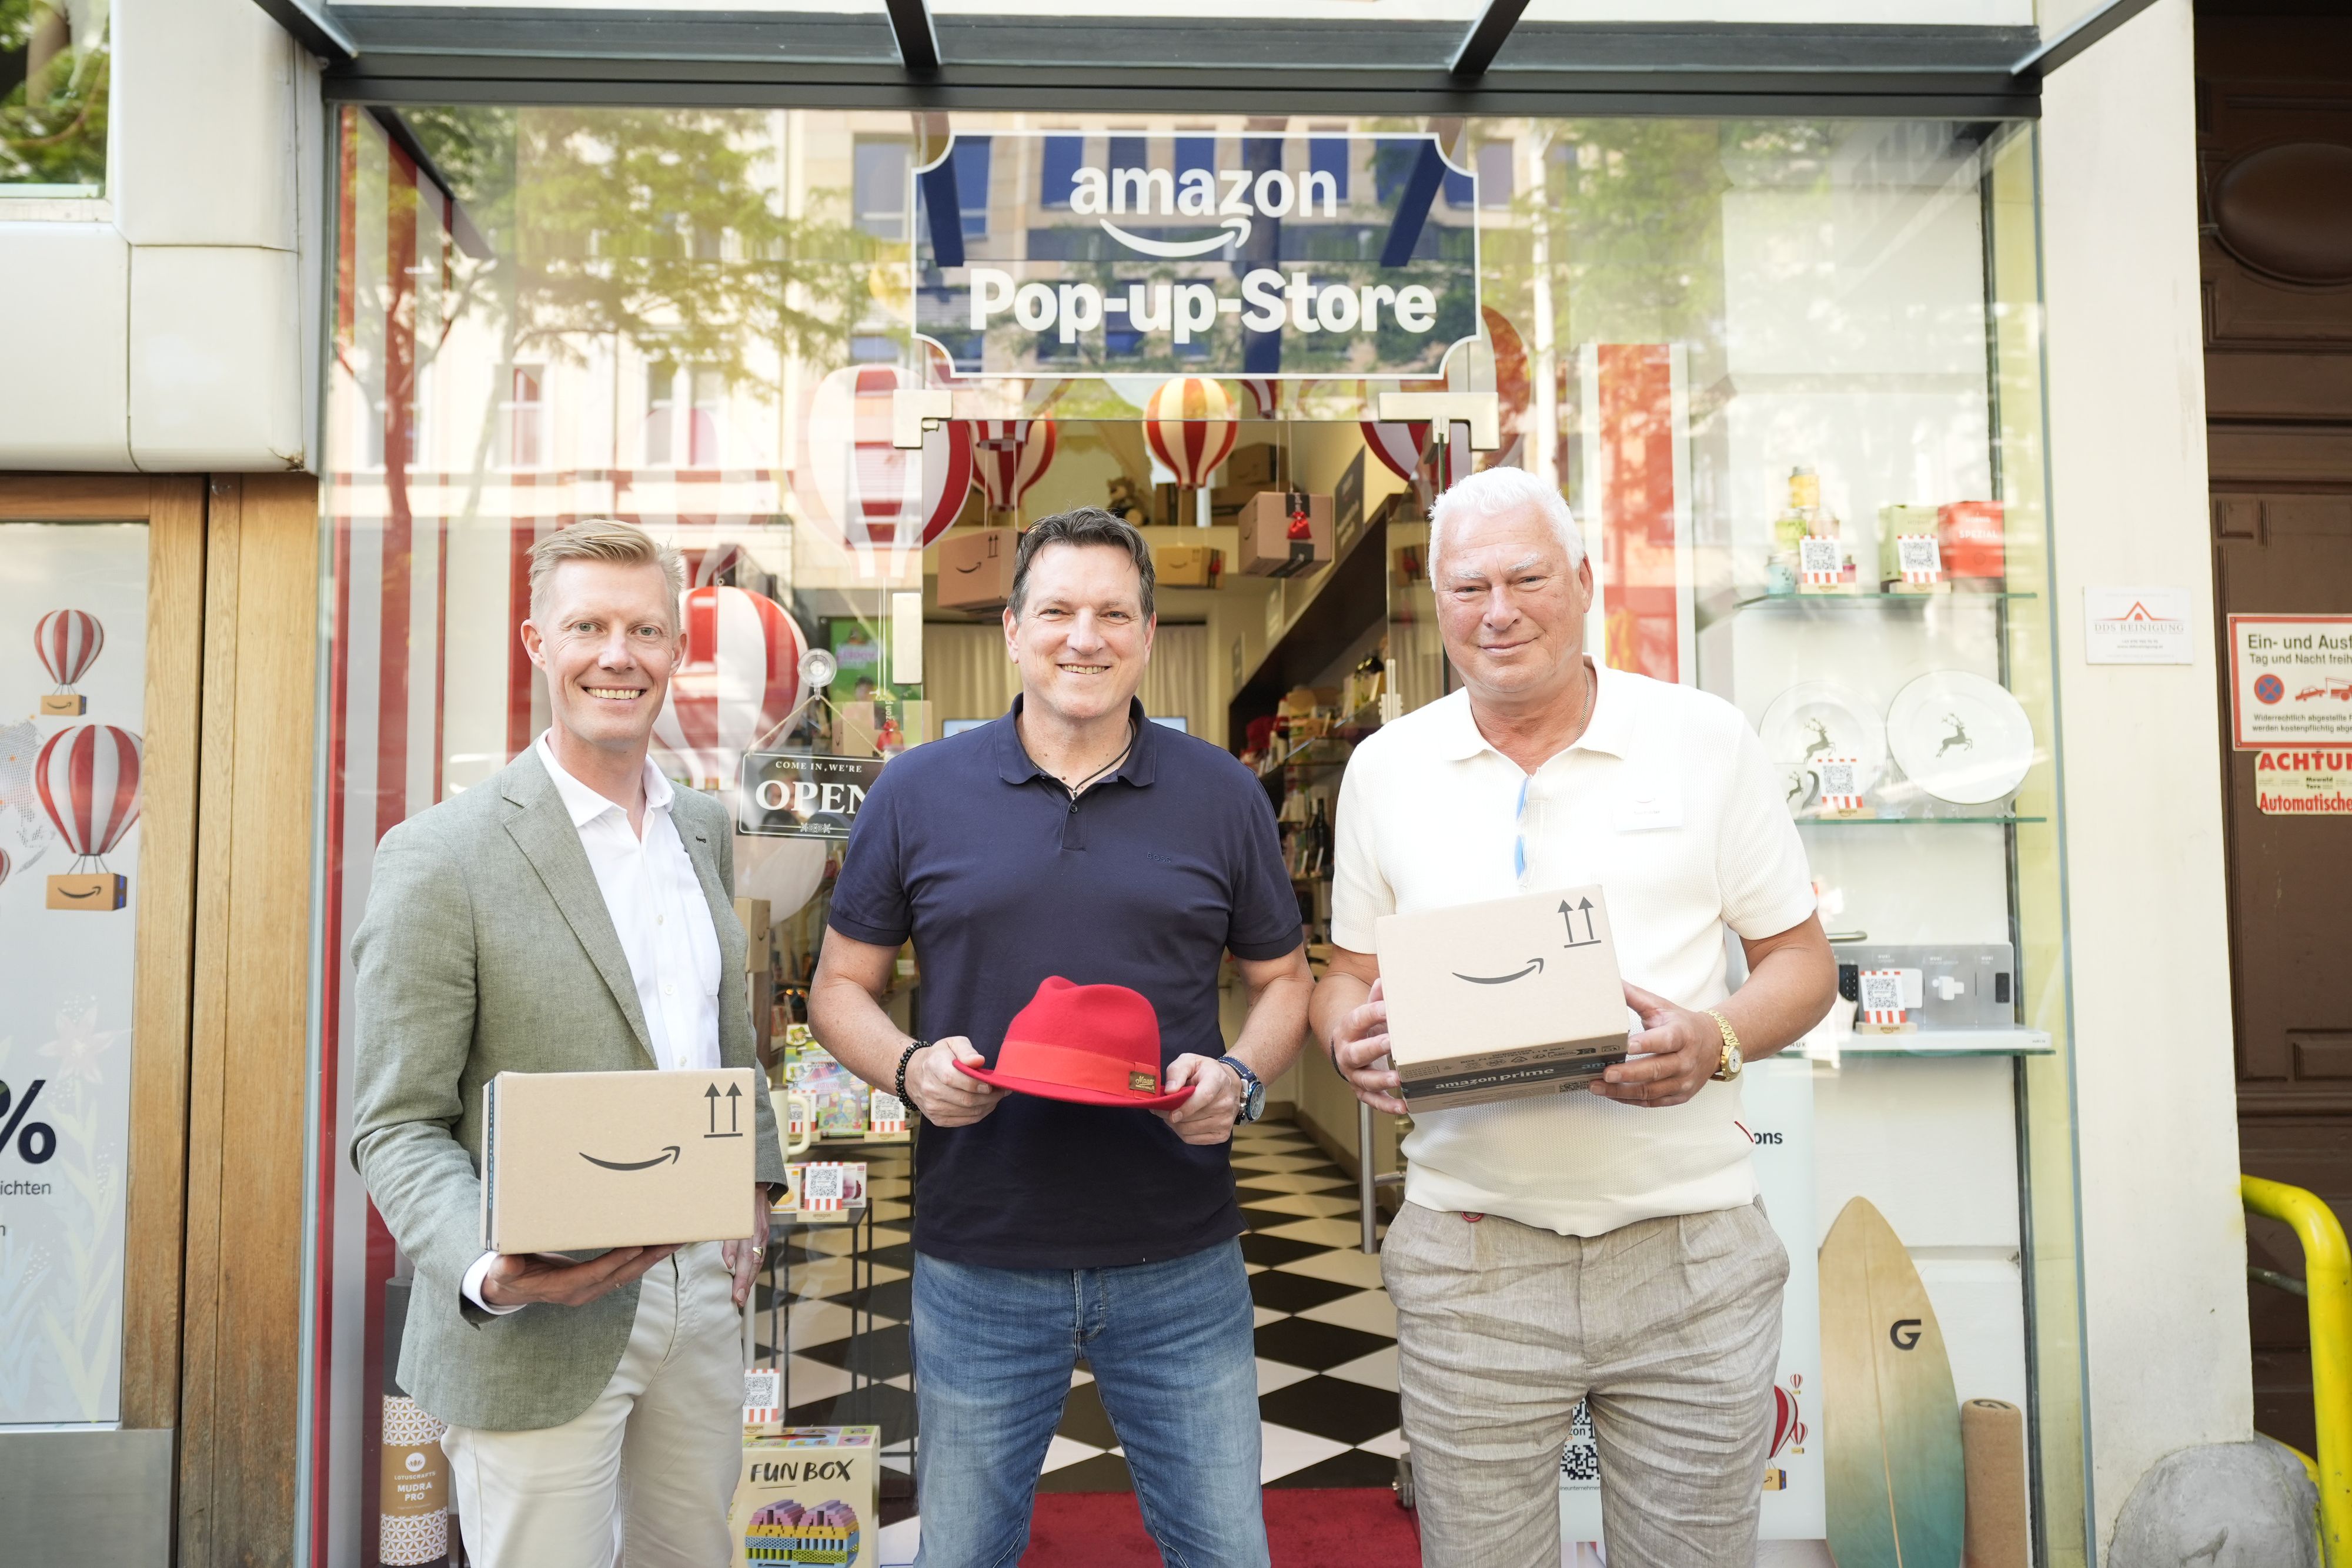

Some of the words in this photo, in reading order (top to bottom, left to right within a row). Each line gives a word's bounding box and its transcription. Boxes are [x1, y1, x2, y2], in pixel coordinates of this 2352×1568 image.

[1070, 166, 1337, 218] amazon
[970, 268, 1437, 344] Pop-up-Store
[1959, 530, 1999, 539] SPEZIAL
[2094, 623, 2117, 633] DDS
[2120, 623, 2184, 633] REINIGUNG
[2248, 634, 2278, 650] Ein-
[2283, 634, 2312, 650] und
[2249, 653, 2269, 667] Tag
[2271, 654, 2291, 664] und
[2296, 654, 2326, 664] Nacht
[2253, 724, 2278, 733] werden
[2281, 724, 2334, 734] kostenpflichtig
[775, 760, 807, 770] COME
[829, 763, 863, 773] WE'RE
[756, 779, 868, 815] OPEN
[1147, 852, 1172, 863] BOSS
[1435, 1075, 1497, 1089] amazon
[1499, 1068, 1555, 1082] prime
[1890, 1319, 1922, 1351] G
[394, 1471, 436, 1480] LOTUSCRAFTS
[750, 1462, 799, 1483] FUN
[803, 1458, 854, 1482] BOX
[397, 1482, 433, 1493] MUDRA
[405, 1492, 425, 1502] PRO
